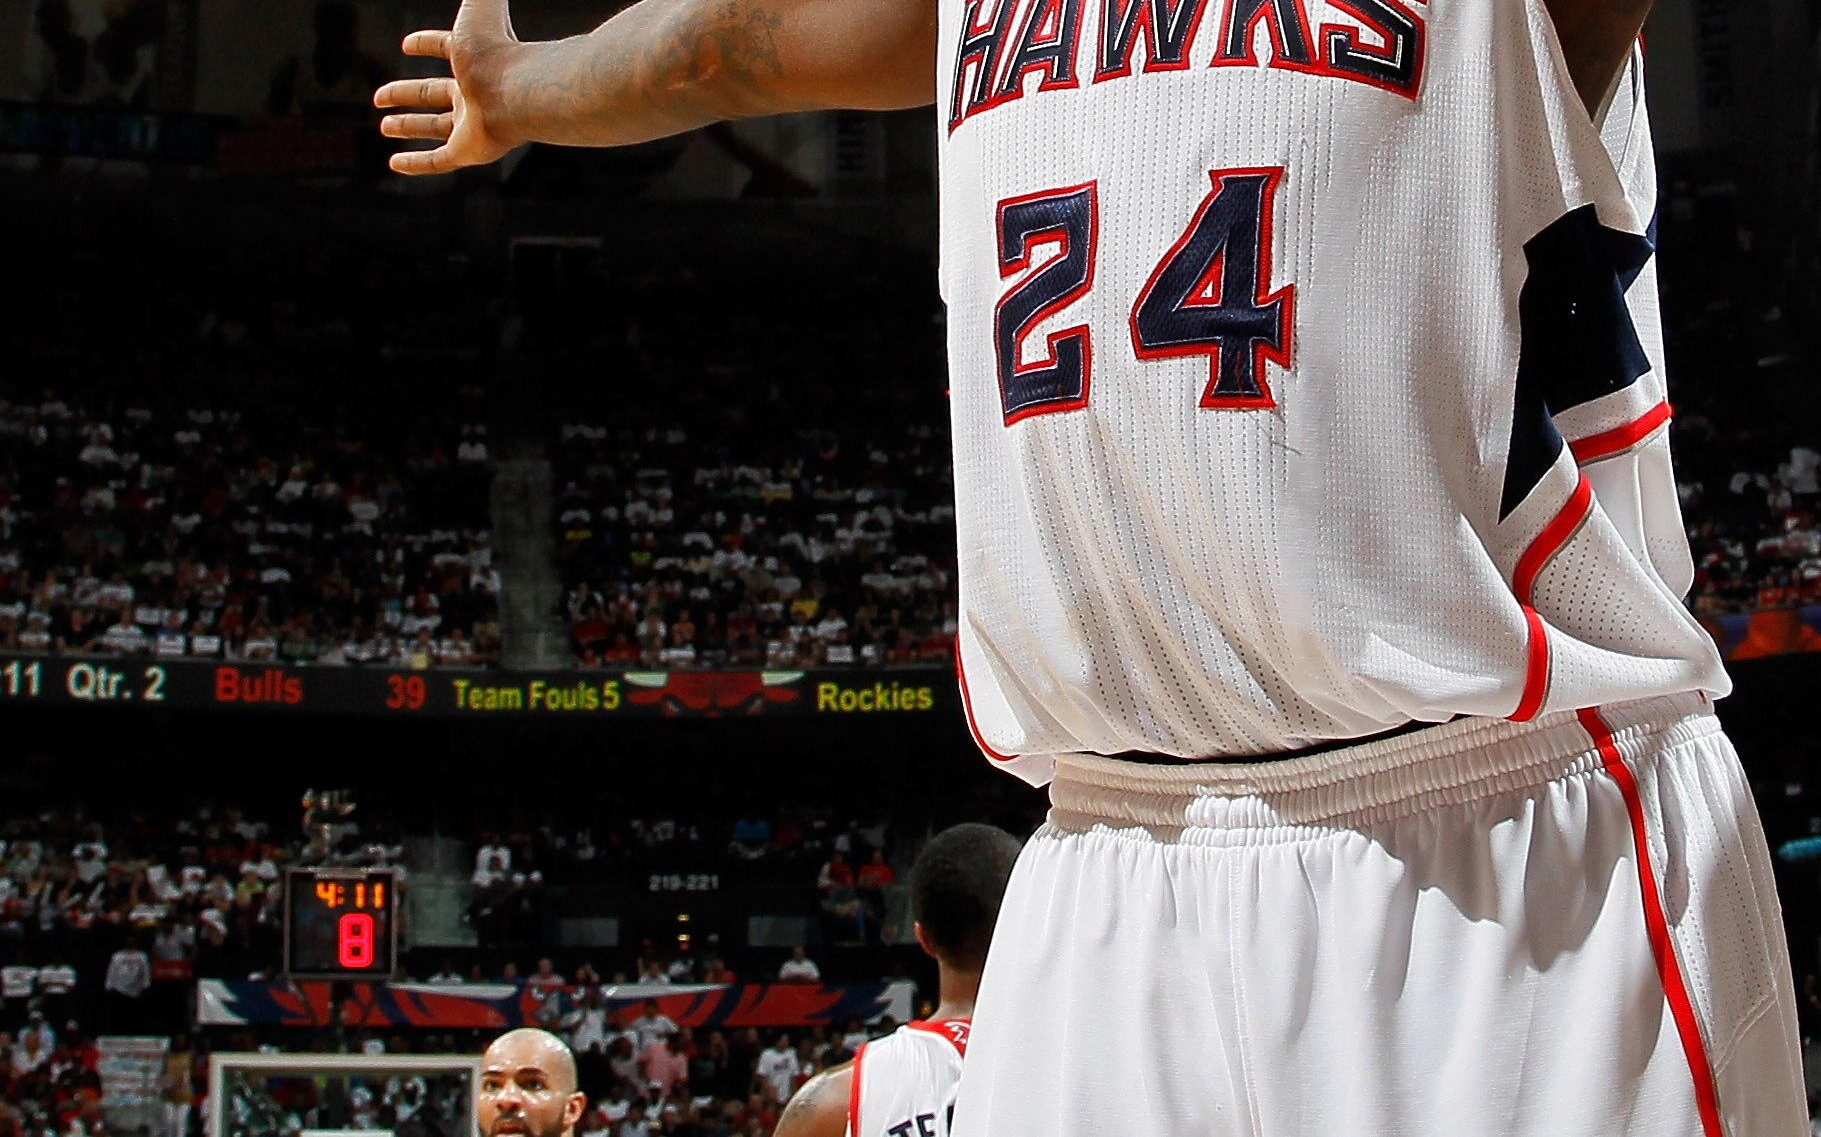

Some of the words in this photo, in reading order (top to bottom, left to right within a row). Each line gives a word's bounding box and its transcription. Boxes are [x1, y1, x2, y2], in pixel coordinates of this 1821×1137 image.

[994, 166, 1296, 428] 24
[65, 663, 133, 701] Qtr.
[143, 665, 167, 701] 2
[215, 667, 303, 704] Bulls
[386, 674, 426, 709] 39
[452, 678, 521, 712] Team
[529, 679, 599, 711] Fouls
[603, 682, 621, 711] 5
[817, 681, 934, 712] Rockies
[316, 881, 384, 909] 4:11
[338, 912, 375, 969] 8
